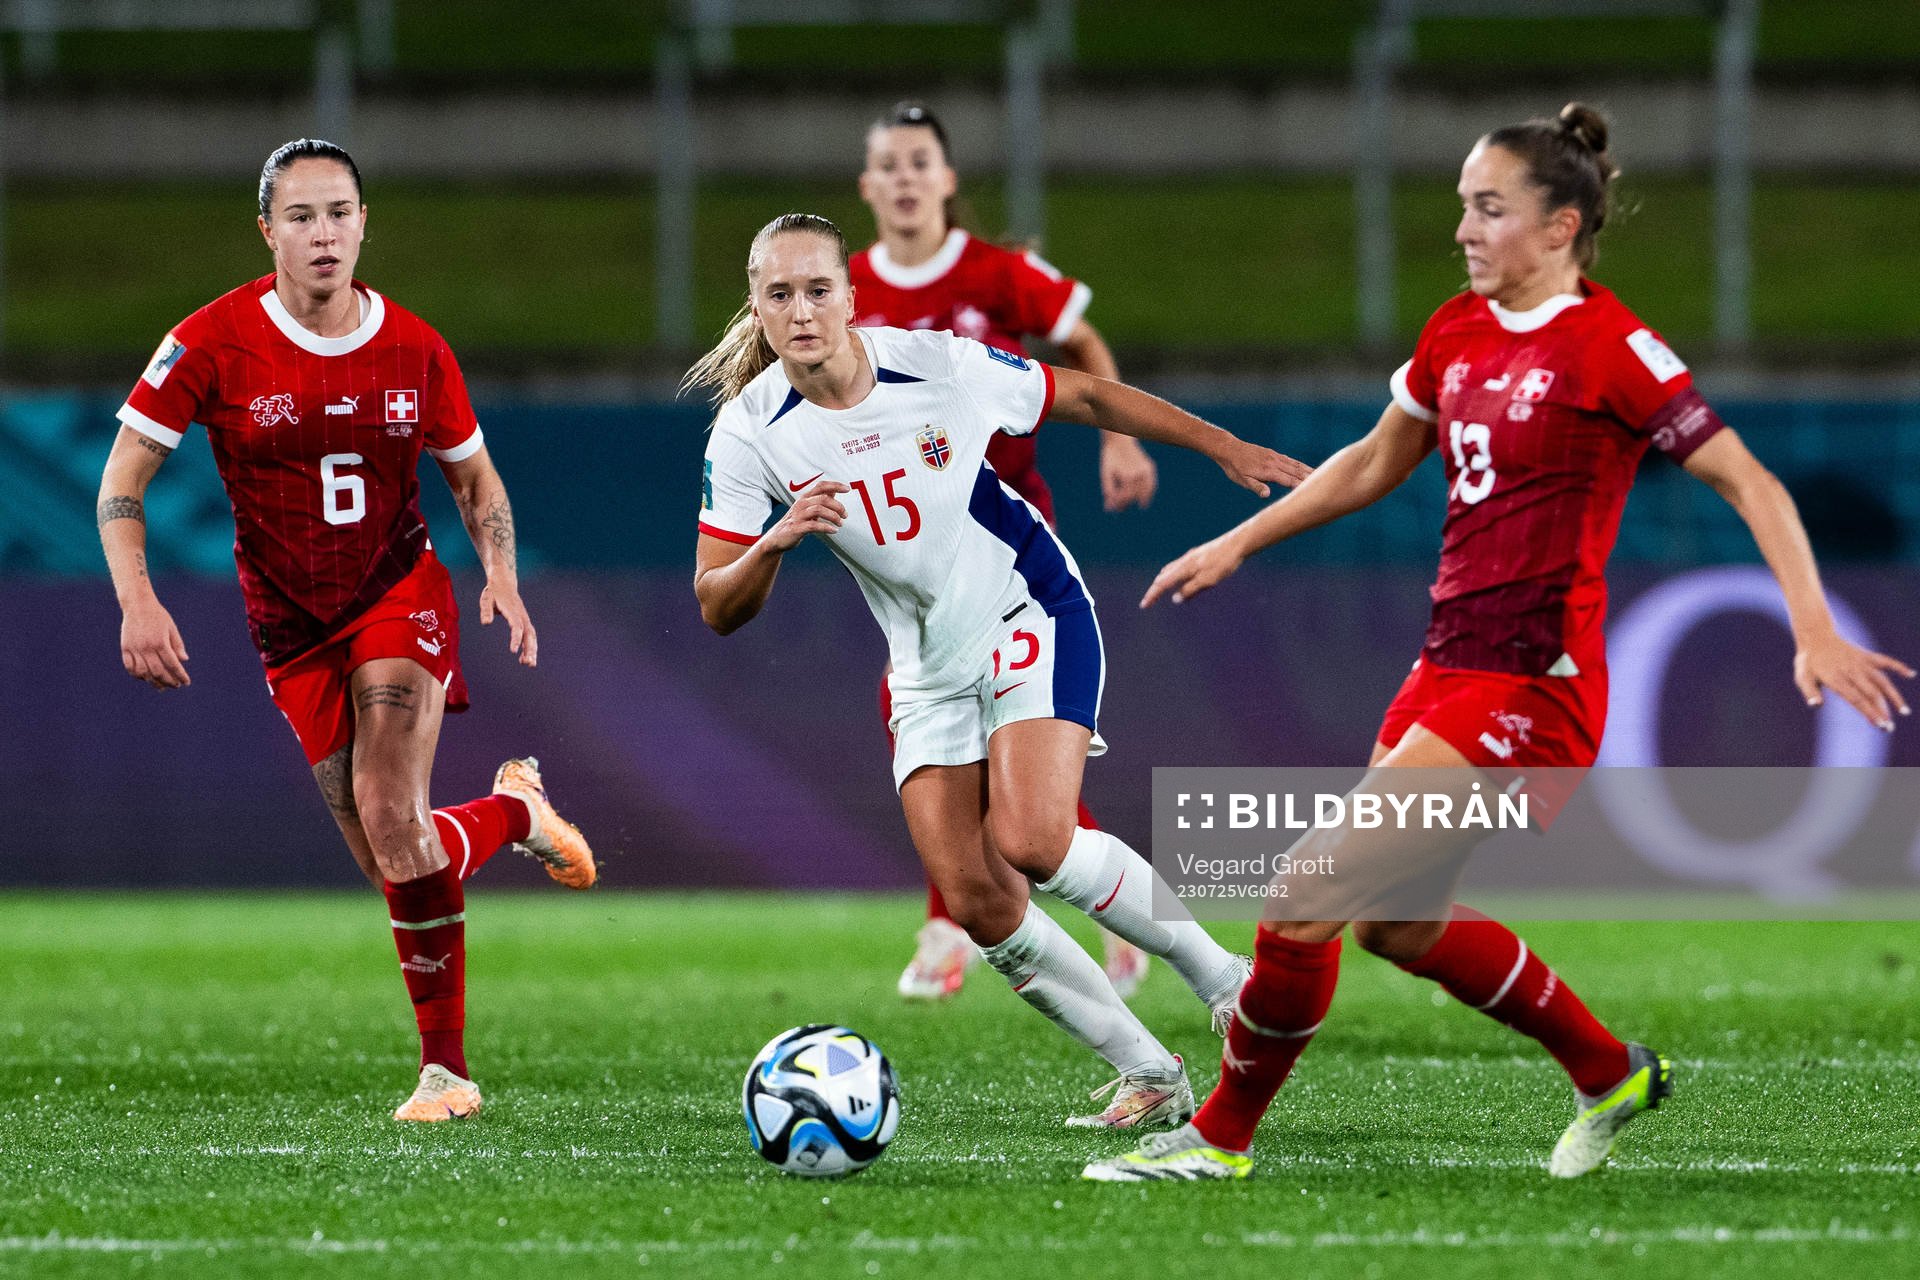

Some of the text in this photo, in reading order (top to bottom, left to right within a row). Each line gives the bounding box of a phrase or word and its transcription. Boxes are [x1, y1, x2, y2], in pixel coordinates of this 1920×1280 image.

[320, 452, 366, 525] 6
[1449, 420, 1496, 505] 13
[849, 467, 921, 546] 15
[1595, 566, 1920, 904] Q
